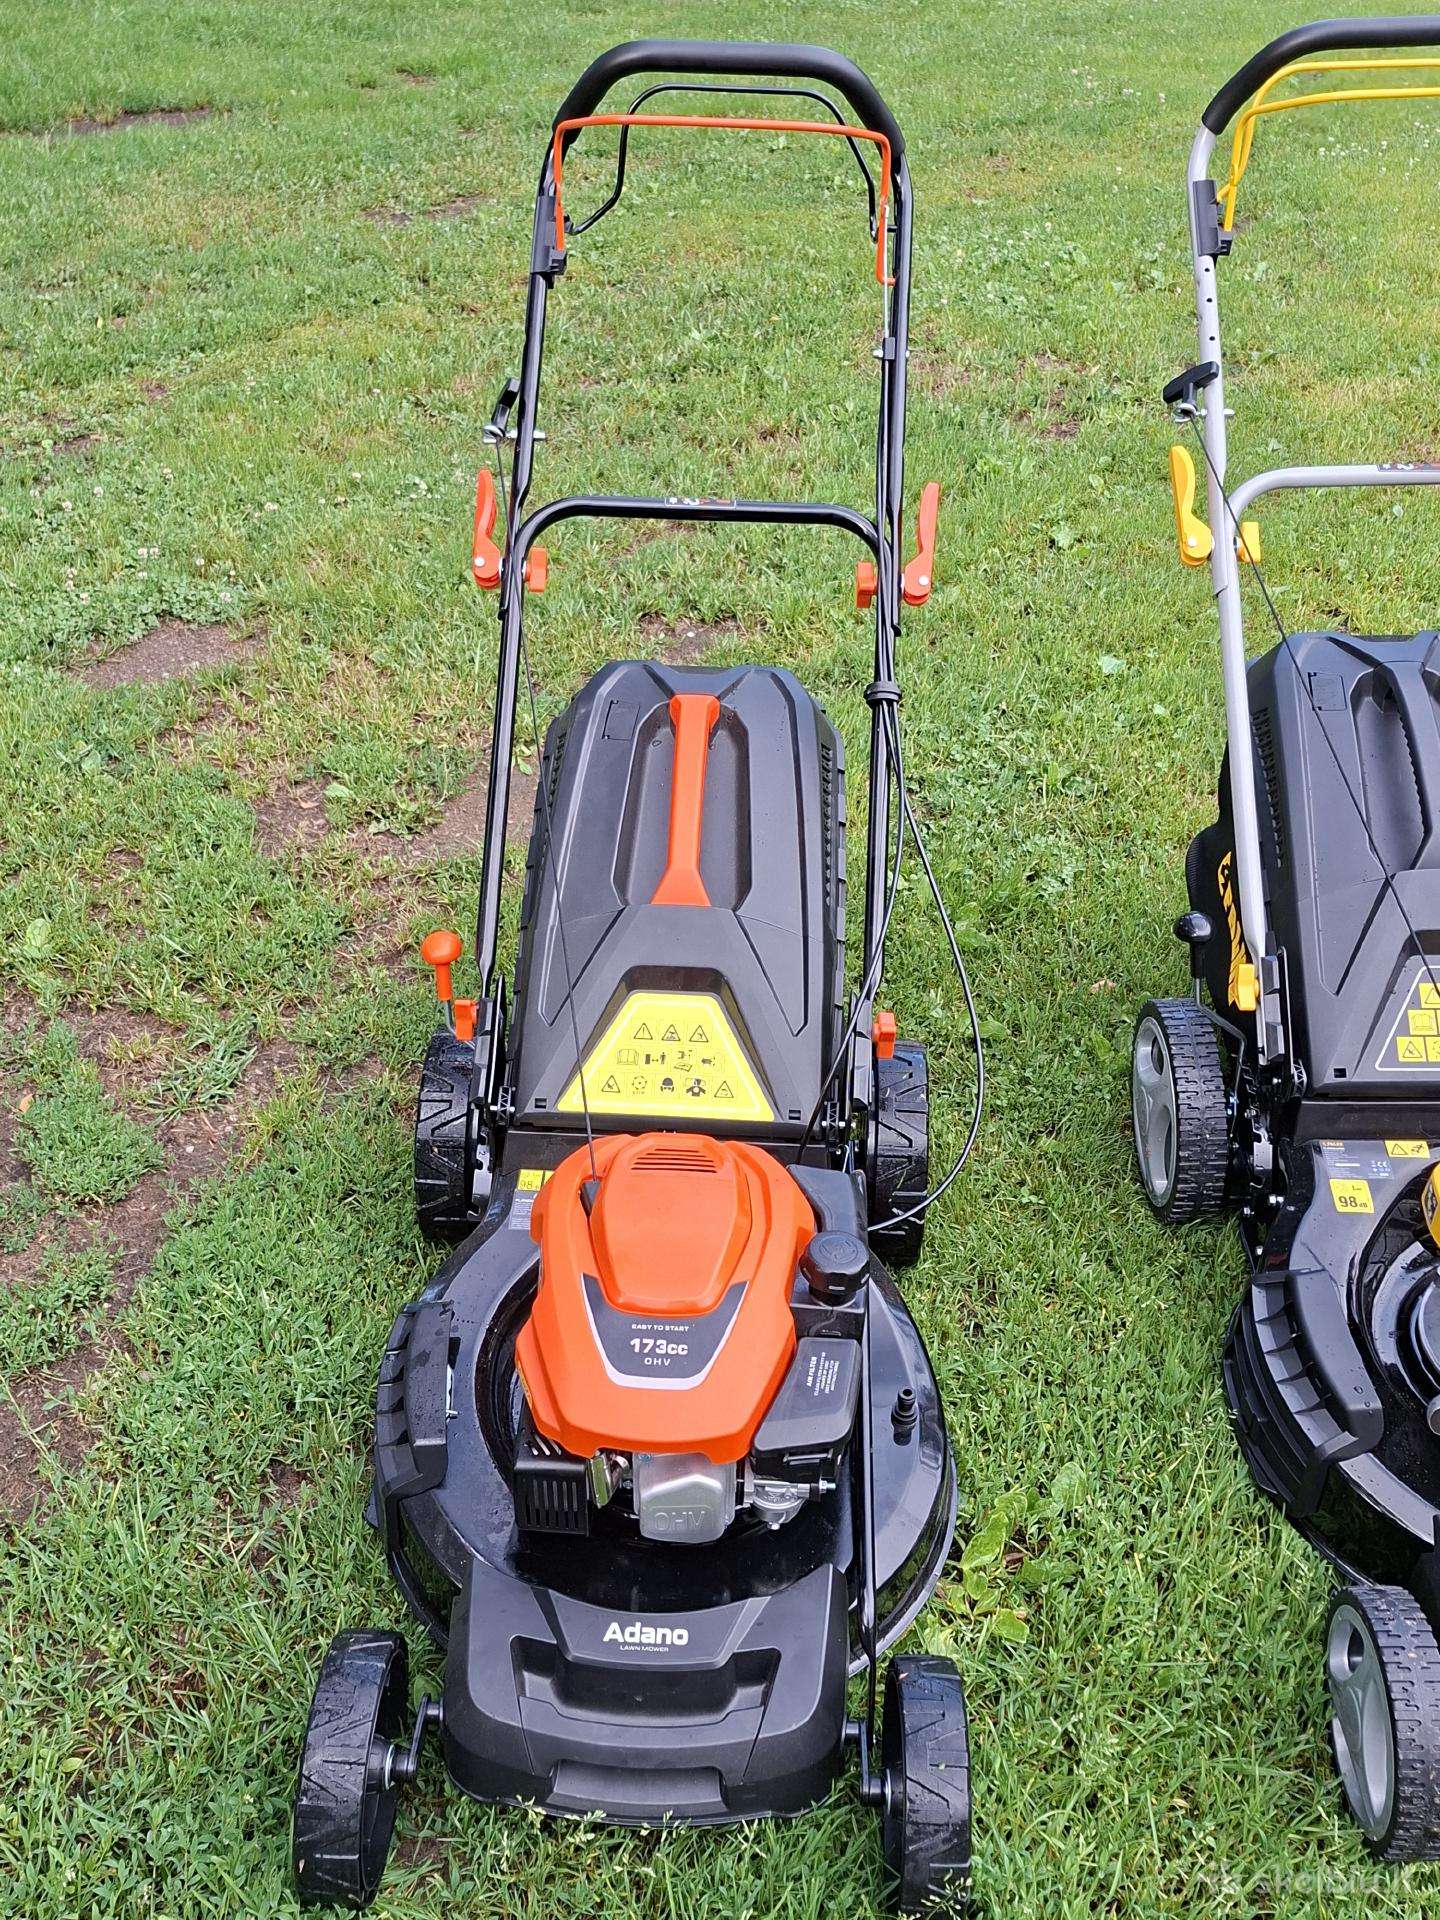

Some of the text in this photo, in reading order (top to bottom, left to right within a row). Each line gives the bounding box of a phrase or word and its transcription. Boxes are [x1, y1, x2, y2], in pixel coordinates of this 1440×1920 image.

[1338, 1195, 1358, 1208] 98
[630, 1337, 688, 1355] 173cc
[655, 1511, 705, 1530] OHV
[602, 1621, 689, 1646] Adano
